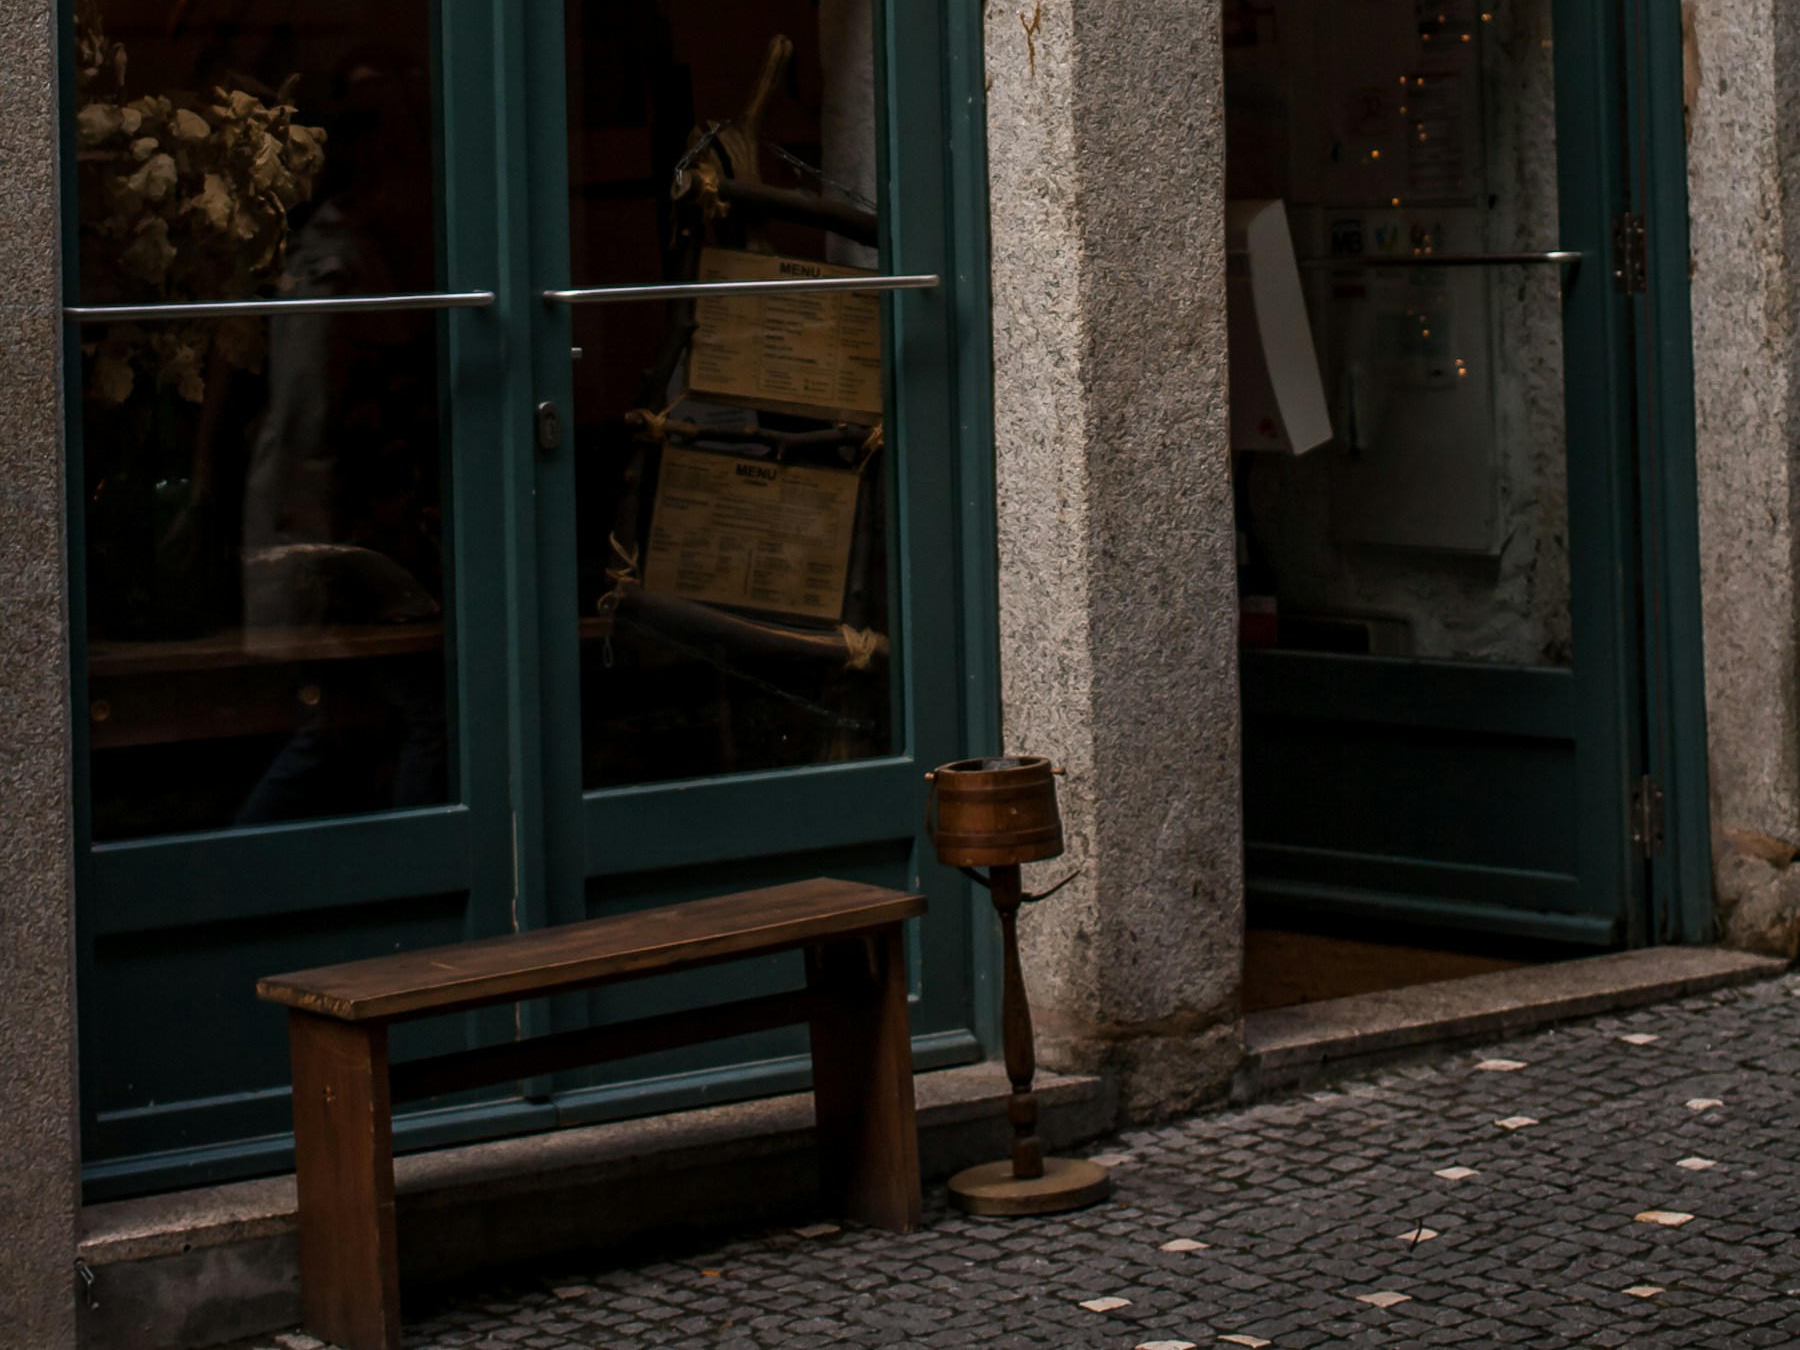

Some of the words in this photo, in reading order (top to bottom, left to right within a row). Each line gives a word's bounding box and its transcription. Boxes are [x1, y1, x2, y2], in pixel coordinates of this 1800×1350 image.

[1331, 230, 1363, 255] MB
[779, 261, 821, 278] MENU
[735, 463, 778, 481] MENU
